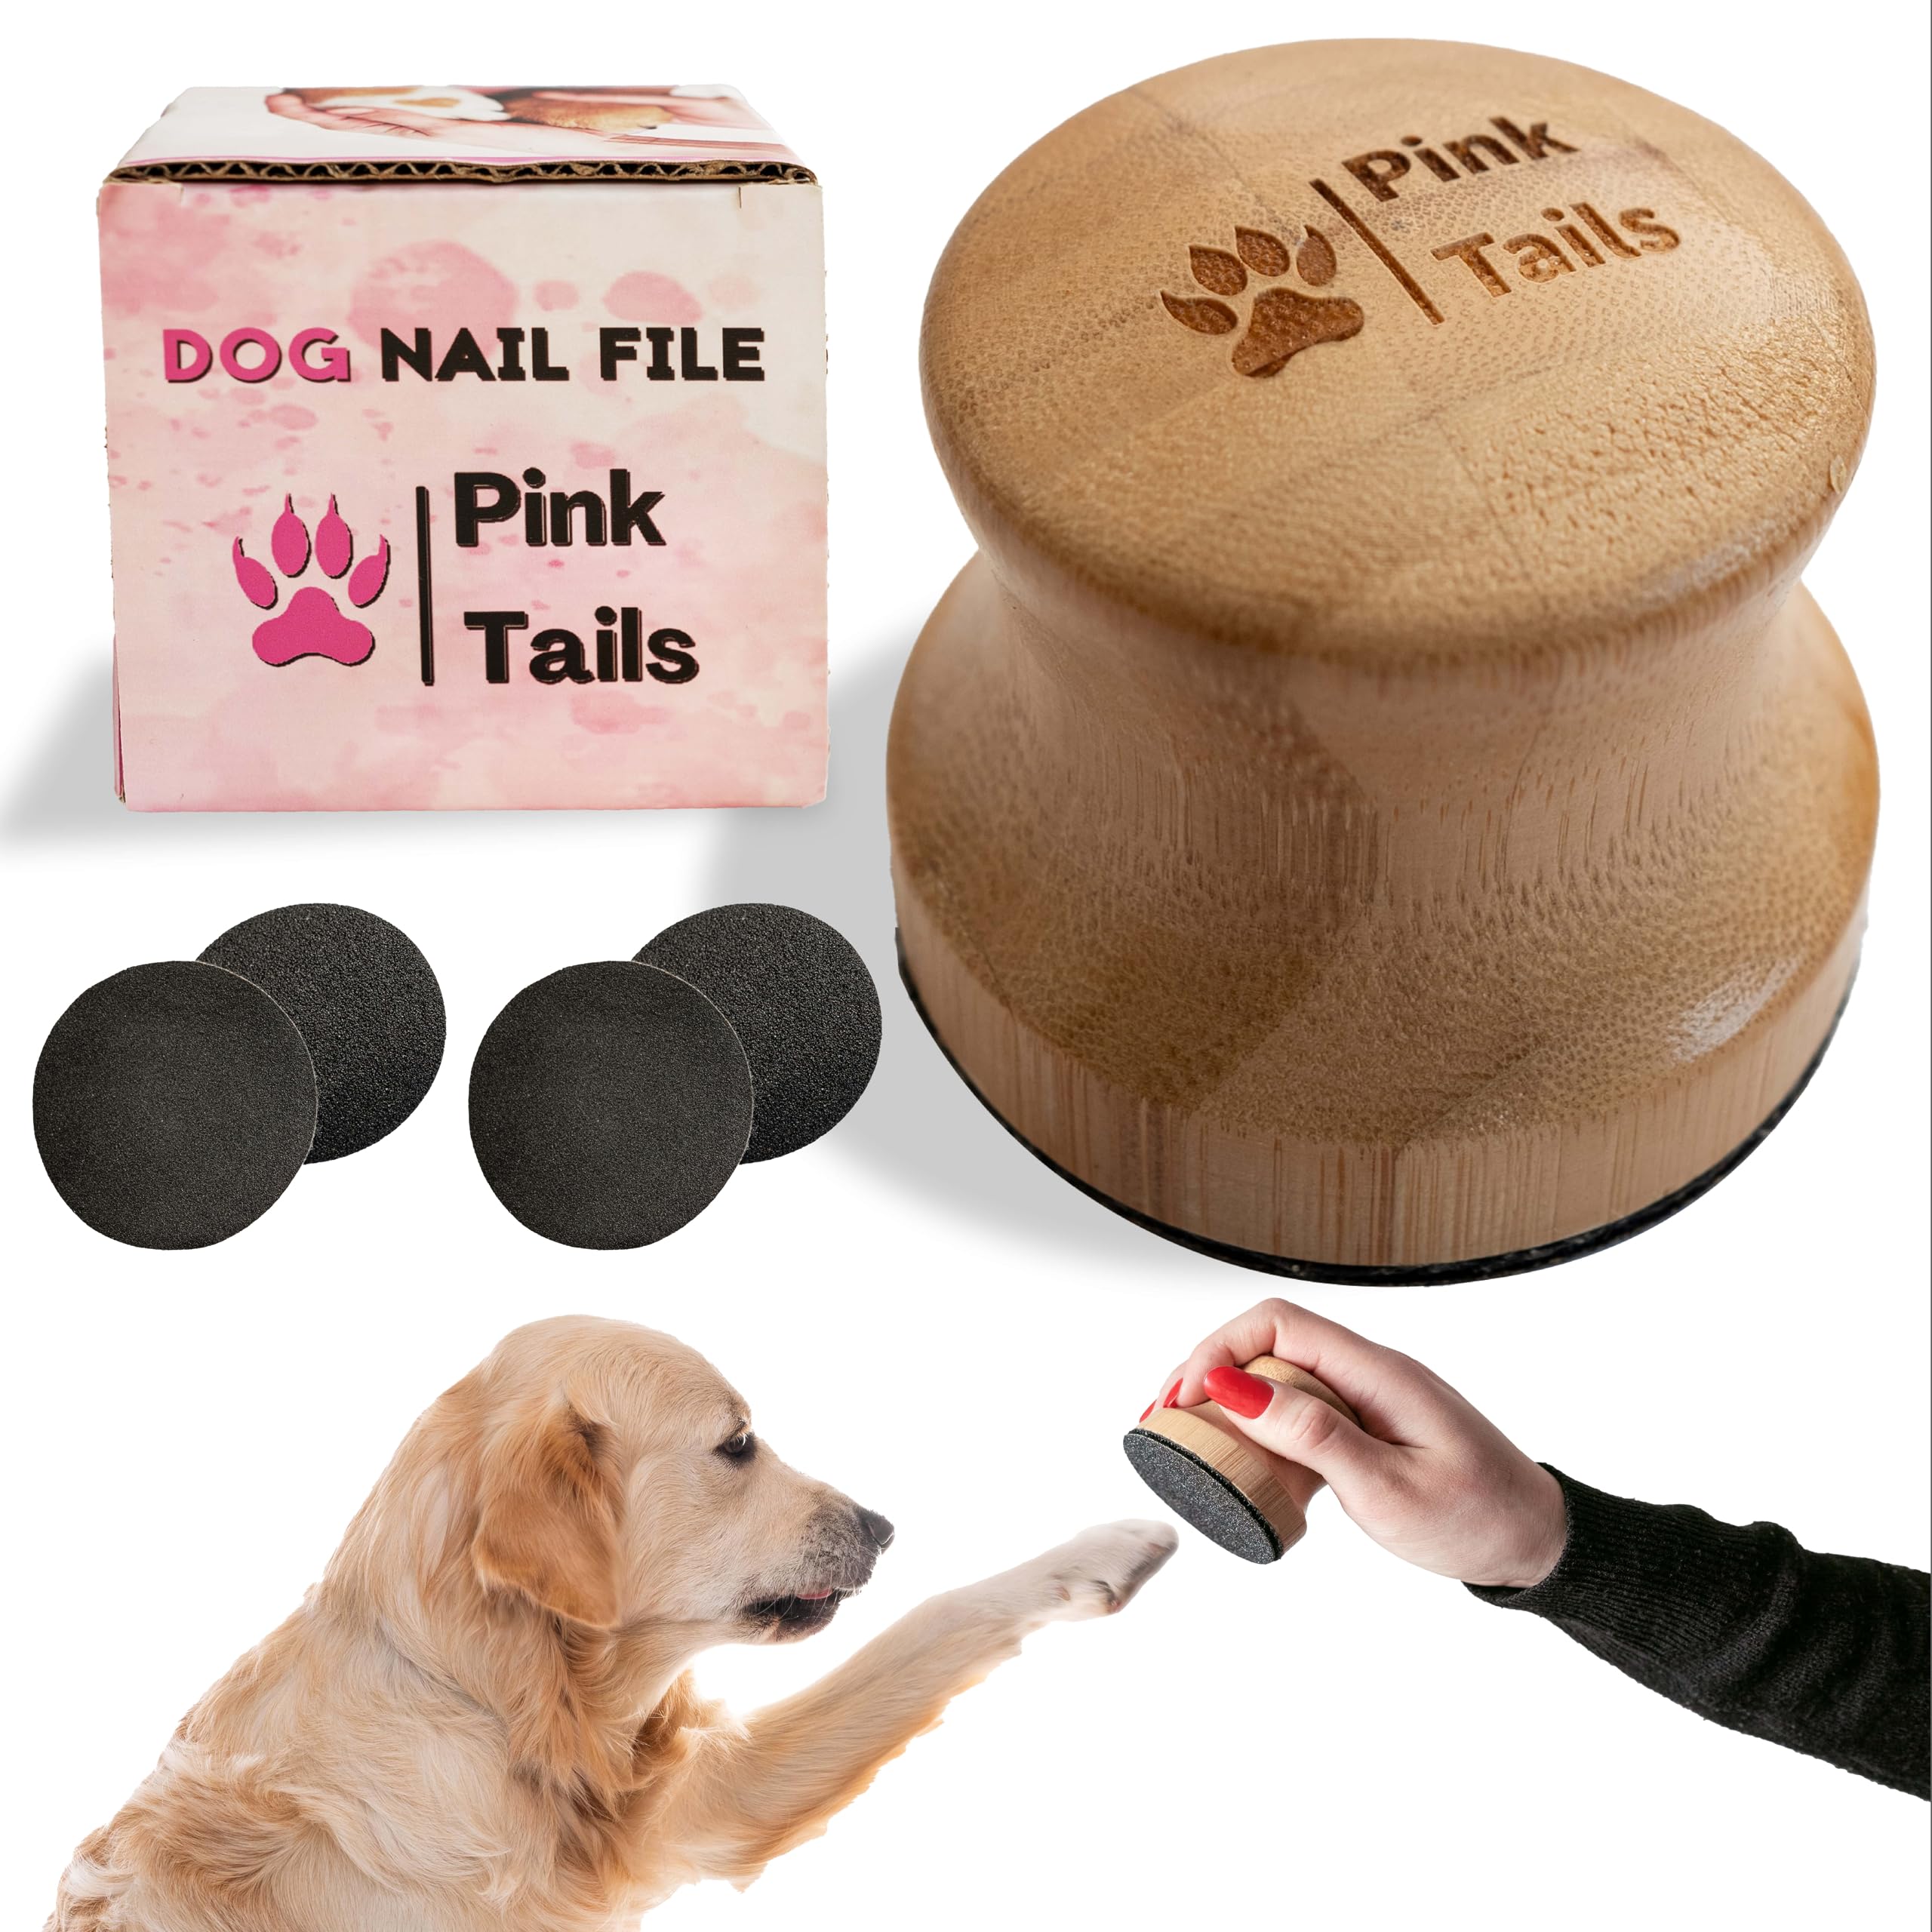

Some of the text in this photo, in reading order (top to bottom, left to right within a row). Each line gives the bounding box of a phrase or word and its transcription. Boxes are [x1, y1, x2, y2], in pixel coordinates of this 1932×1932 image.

[1342, 115, 1580, 202] Pink
[1432, 202, 1681, 297] Tails
[163, 327, 765, 383] DOG NAIL FILE
[454, 467, 666, 547] Pink
[463, 607, 700, 685] Tails
